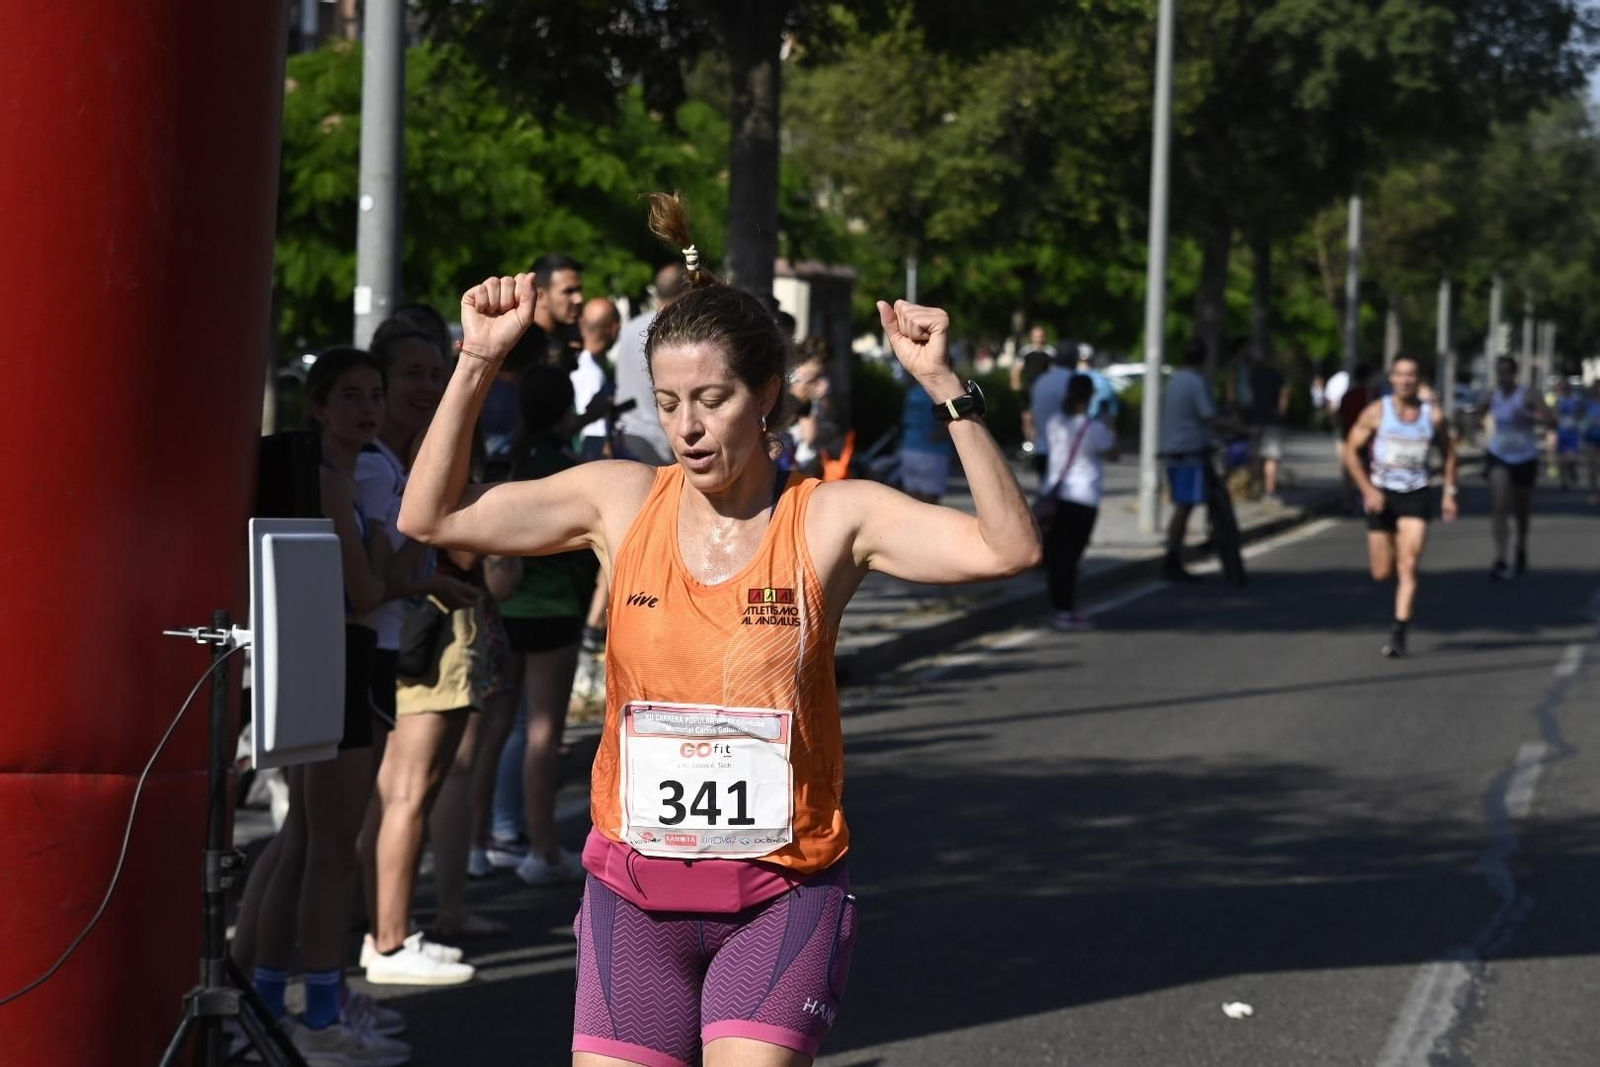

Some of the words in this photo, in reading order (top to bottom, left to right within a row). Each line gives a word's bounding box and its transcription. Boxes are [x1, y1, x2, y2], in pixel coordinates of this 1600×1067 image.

[626, 591, 659, 608] vive
[742, 606, 799, 616] ATLETISMO
[741, 616, 753, 625] AL
[754, 616, 801, 627] ANDALUS
[655, 714, 683, 723] CARRERA
[684, 715, 715, 724] POPULAR
[679, 742, 712, 758] GO
[713, 743, 732, 757] fit
[658, 779, 755, 826] 341
